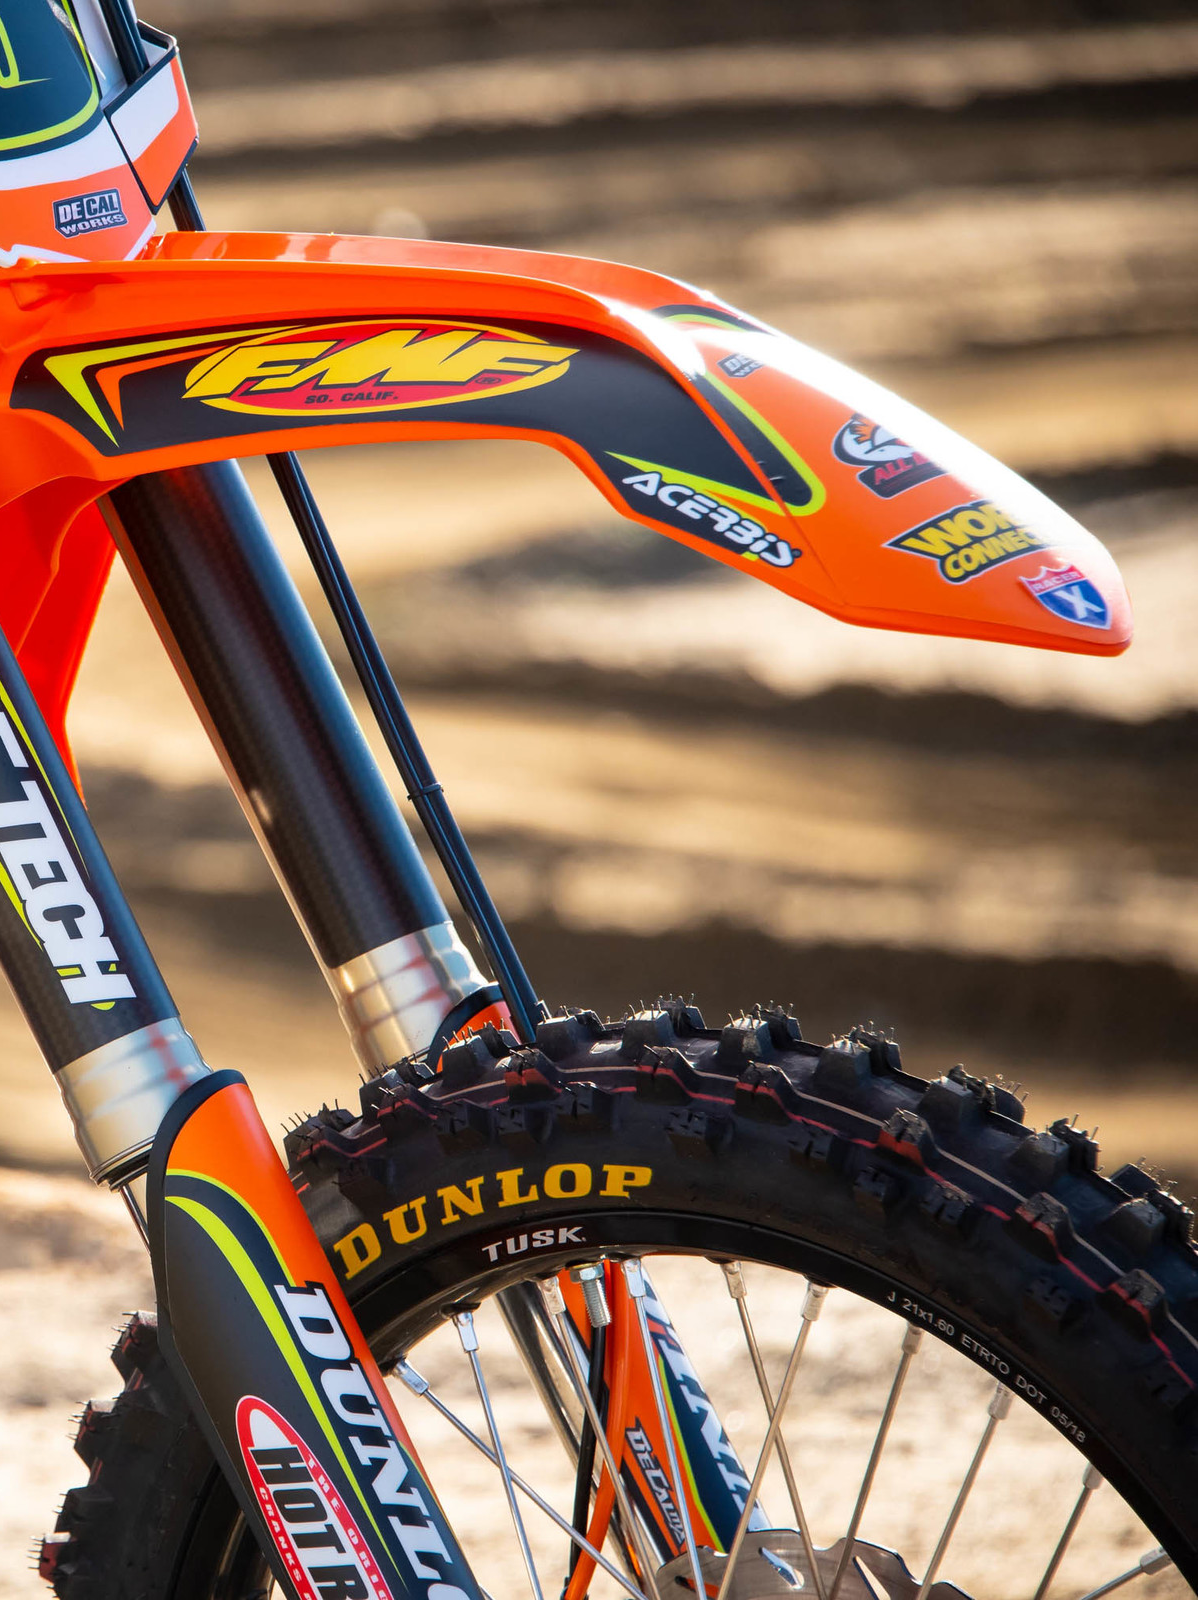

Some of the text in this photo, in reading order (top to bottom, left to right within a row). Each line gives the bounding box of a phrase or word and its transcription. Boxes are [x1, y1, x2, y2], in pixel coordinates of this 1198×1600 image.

[61, 214, 125, 235] WORKS
[182, 328, 581, 400] FMF
[305, 391, 399, 405] SO. CALIF.
[899, 503, 1020, 557] WOR
[944, 528, 1042, 579] CONNEC
[1032, 571, 1082, 592] RACER
[1052, 585, 1105, 620] X
[333, 1162, 653, 1281] DUNLOP
[902, 1297, 955, 1336] 21x1.60
[960, 1333, 1010, 1376] ETRTO
[1014, 1374, 1048, 1405] DOT
[1051, 1406, 1087, 1444] 05/18
[274, 1280, 470, 1600] DUNL
[308, 1453, 341, 1512] THE
[259, 1487, 303, 1582] CRANKS
